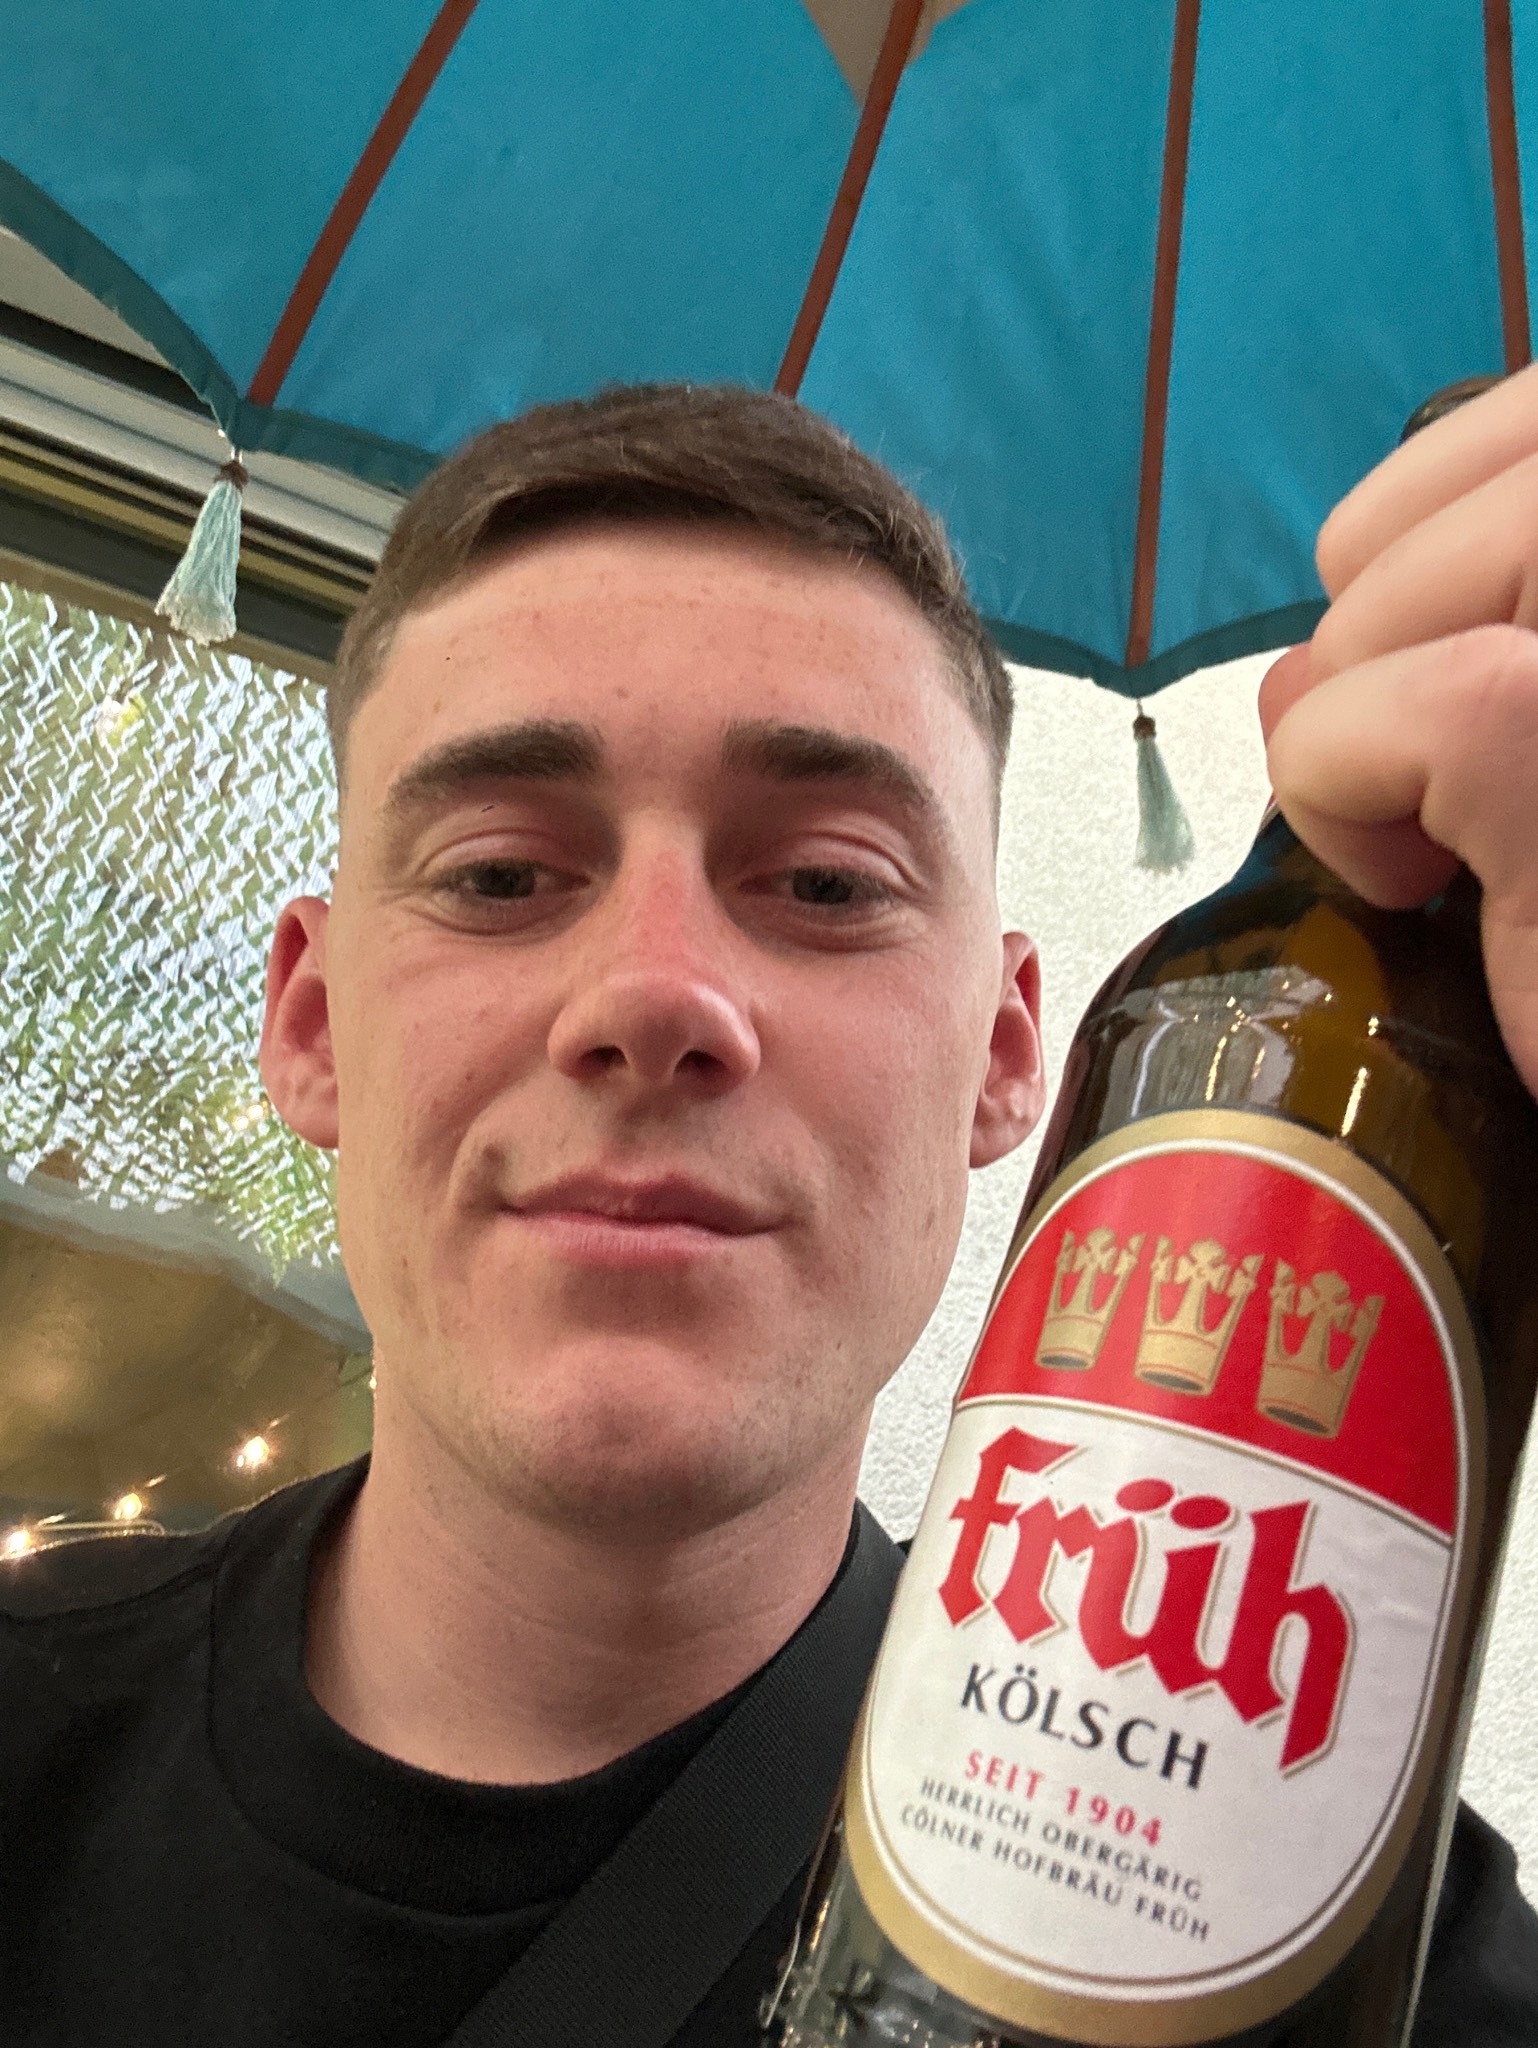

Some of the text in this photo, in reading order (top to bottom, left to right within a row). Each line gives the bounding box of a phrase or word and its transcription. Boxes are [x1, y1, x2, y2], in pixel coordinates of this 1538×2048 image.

[961, 1663, 1208, 1790] KÖLSCH
[920, 1776, 1202, 1901] HERRLICH OBERGÄRIG
[964, 1749, 1162, 1846] SEIT 1904
[901, 1803, 1210, 1942] CÖLNER HOFBRÄU FRÜH
